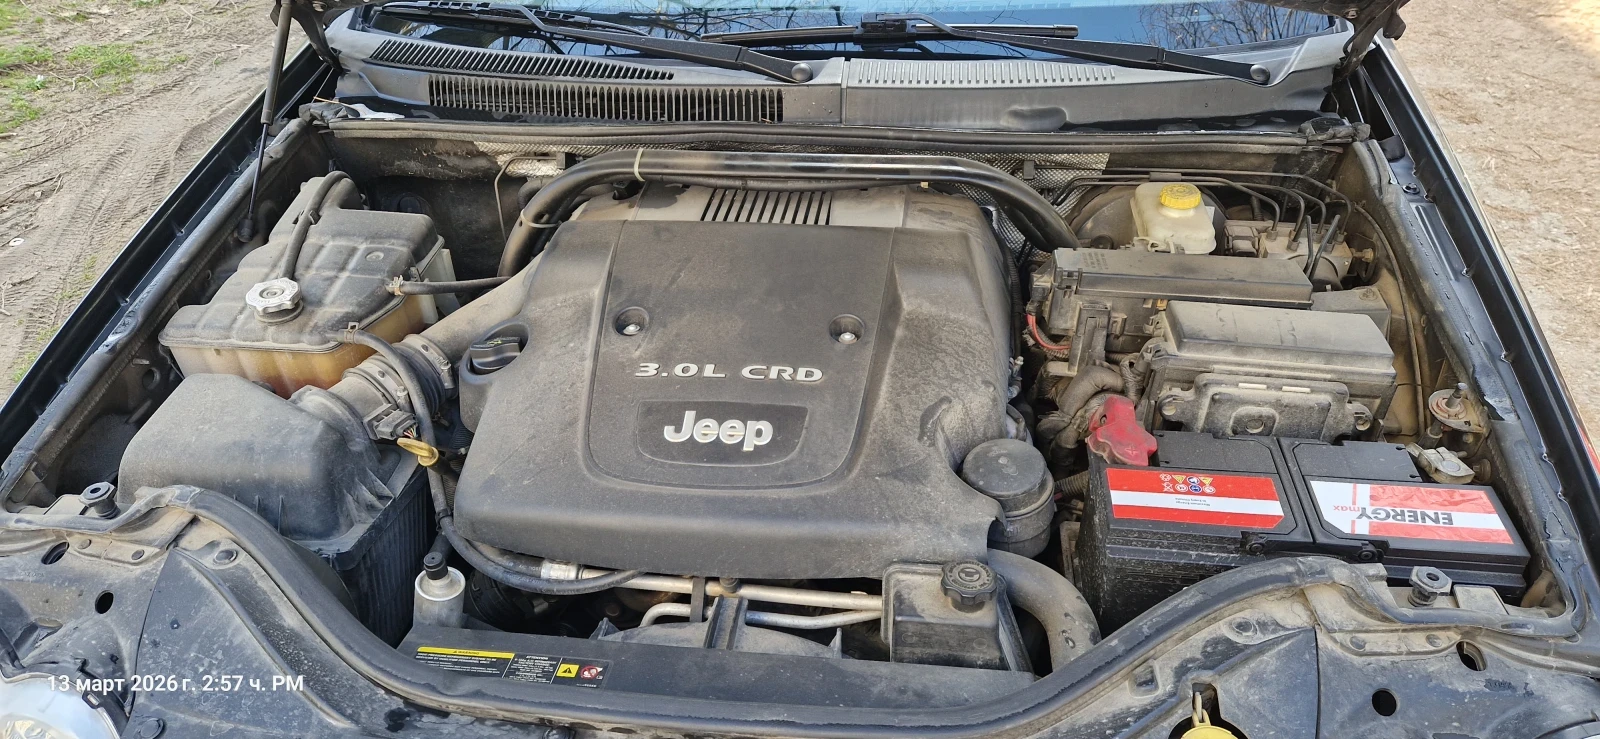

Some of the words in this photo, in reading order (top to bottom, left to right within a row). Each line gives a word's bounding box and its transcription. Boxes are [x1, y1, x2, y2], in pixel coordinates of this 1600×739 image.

[635, 362, 727, 378] 3.0L
[741, 365, 824, 383] CRD
[663, 410, 774, 452] Jeep
[1356, 506, 1454, 526] ENERGY
